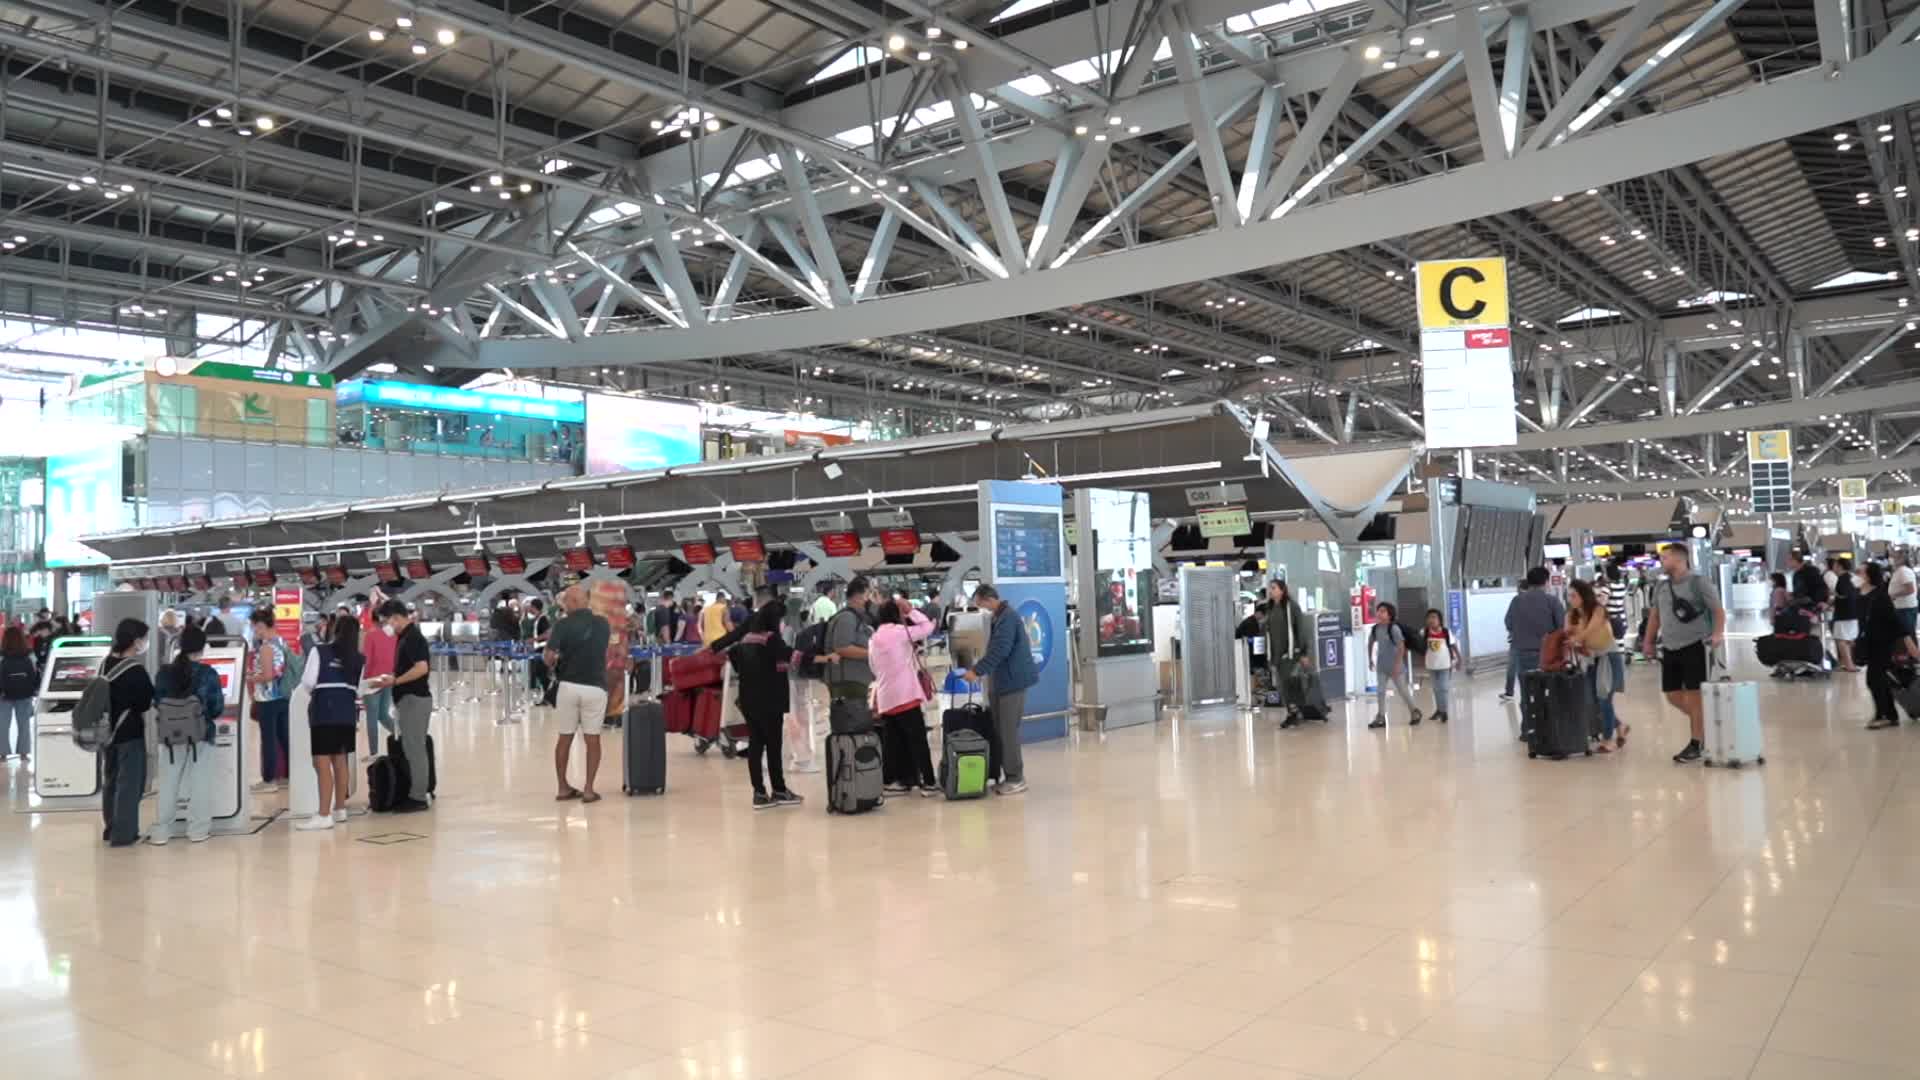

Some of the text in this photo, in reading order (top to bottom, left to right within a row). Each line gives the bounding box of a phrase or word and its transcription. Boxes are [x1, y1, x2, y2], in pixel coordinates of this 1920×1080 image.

[1440, 266, 1487, 320] C
[1760, 433, 1777, 459] E
[1190, 490, 1211, 500] C01
